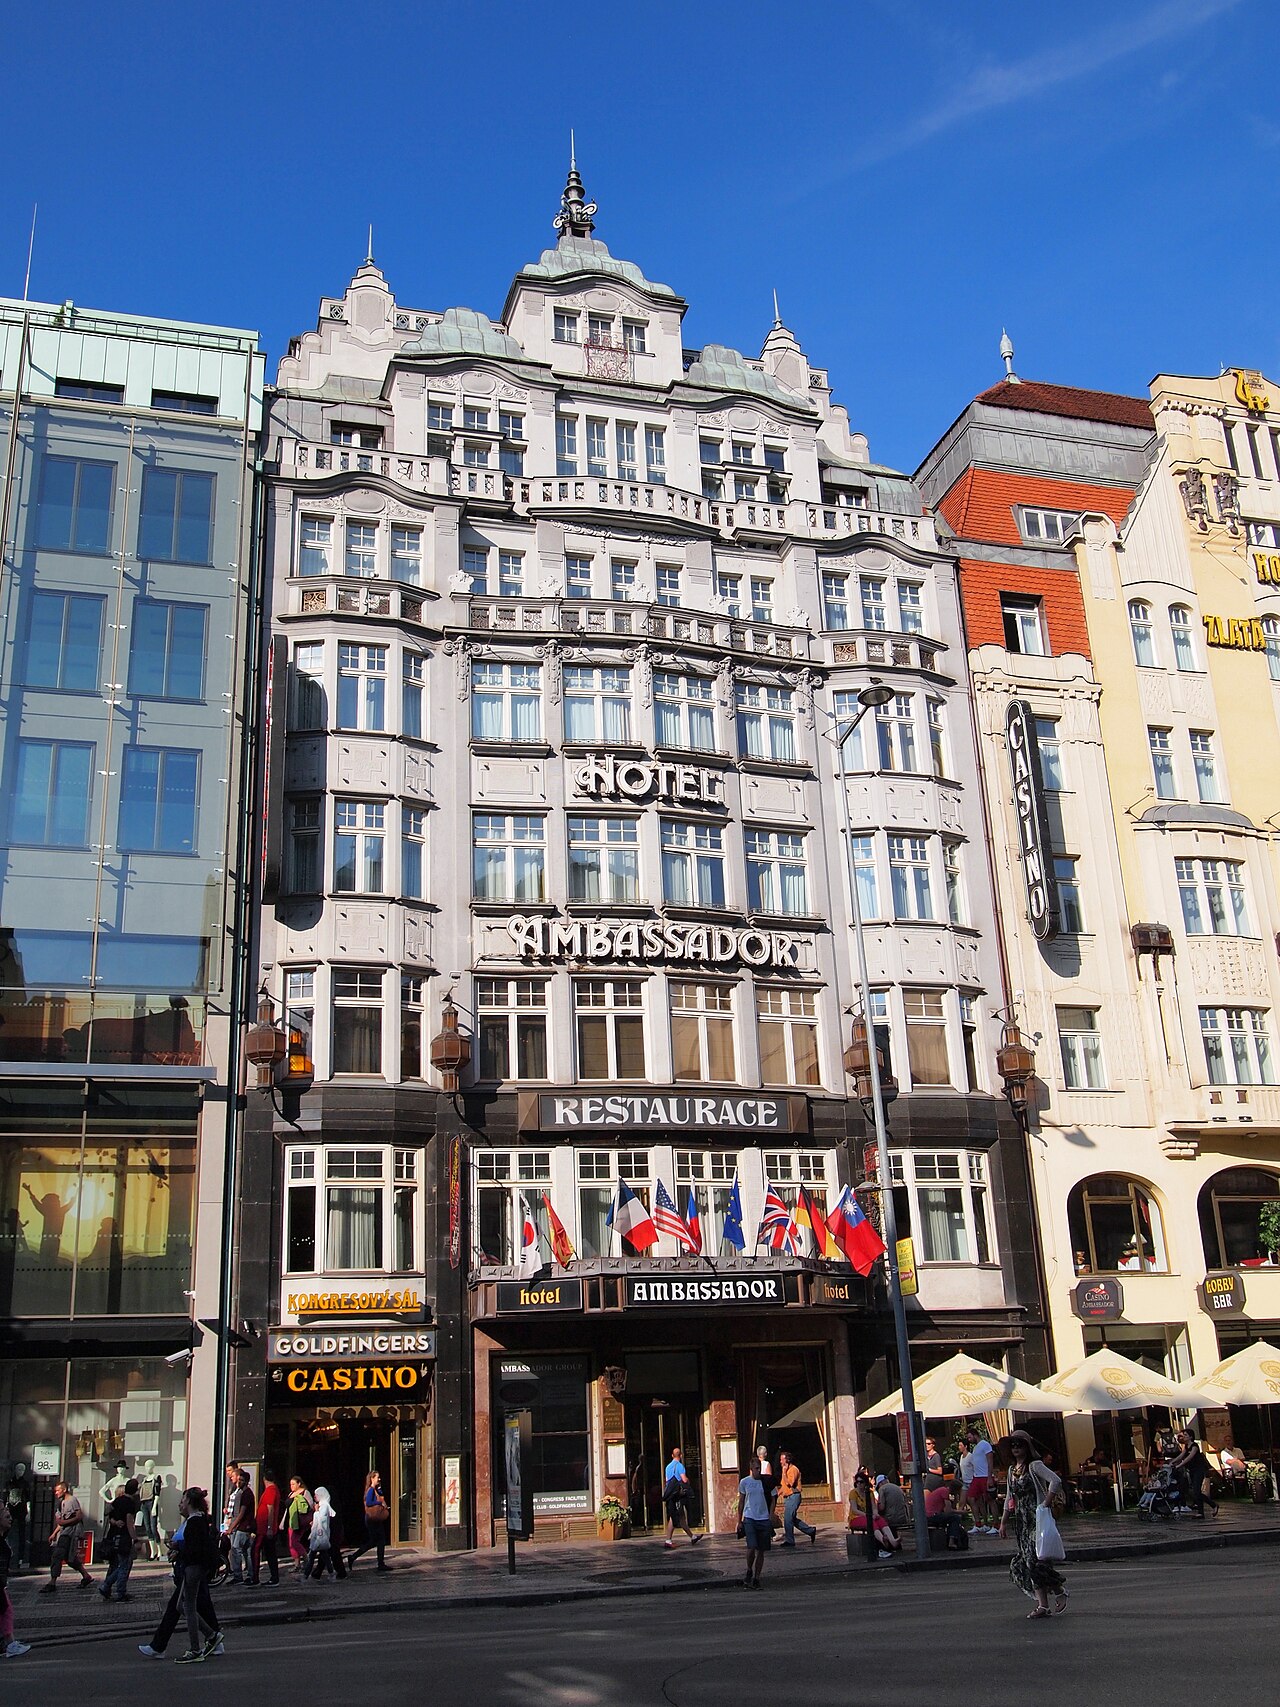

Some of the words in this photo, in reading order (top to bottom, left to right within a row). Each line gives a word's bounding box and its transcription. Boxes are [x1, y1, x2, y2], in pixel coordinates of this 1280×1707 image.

[574, 753, 724, 803] HOTEL
[1009, 716, 1045, 919] CASINO
[506, 914, 798, 967] AMBASSADOR
[554, 1096, 779, 1127] RESTAURACE
[633, 1280, 778, 1301] AMBASSADOR
[823, 1284, 850, 1300] hotel
[1205, 1276, 1234, 1294] LOBBY
[287, 1289, 390, 1310] KONGRESOVÝ
[393, 1288, 421, 1309] SÁL
[519, 1287, 561, 1305] hotel
[1212, 1294, 1233, 1309] BAR
[275, 1335, 429, 1354] GOLDFINGERS
[287, 1366, 418, 1392] CASINO
